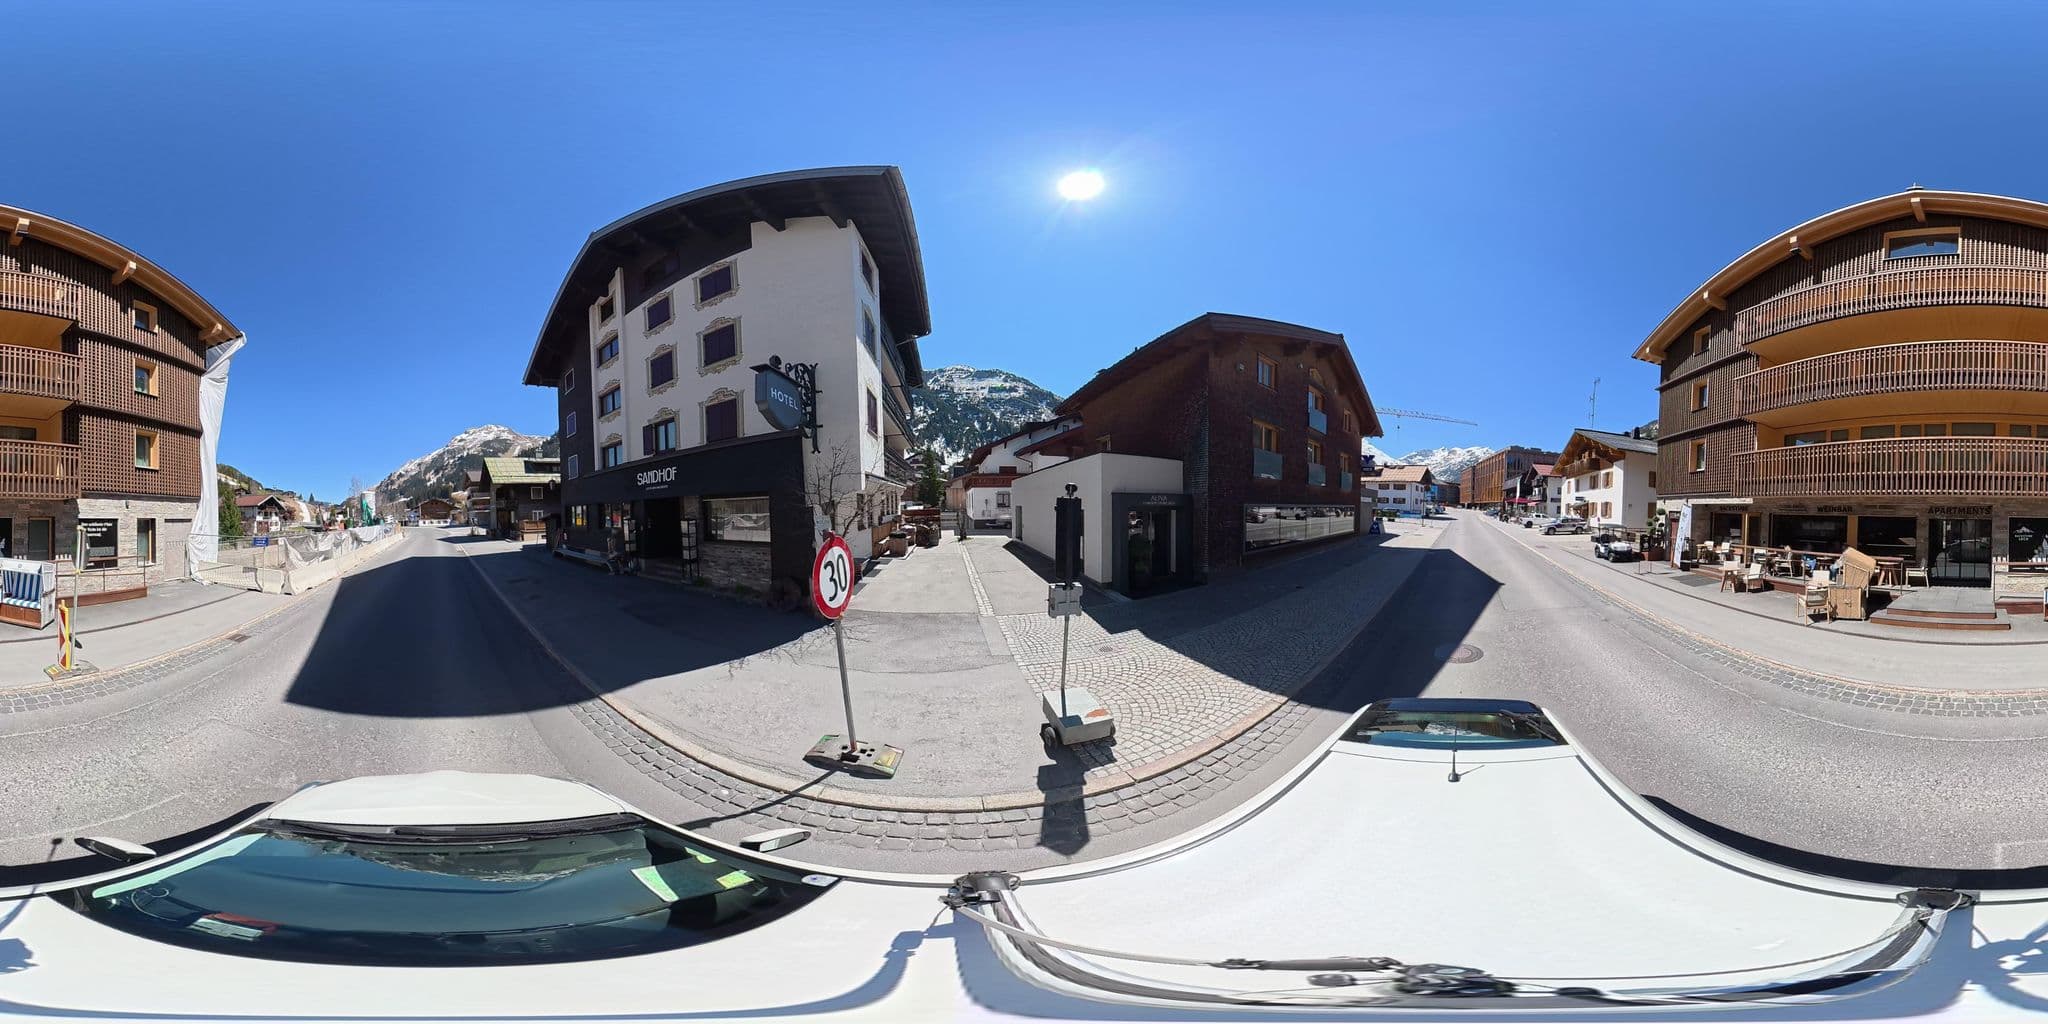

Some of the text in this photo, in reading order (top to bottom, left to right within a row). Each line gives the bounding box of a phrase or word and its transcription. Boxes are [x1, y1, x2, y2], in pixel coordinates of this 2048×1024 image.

[770, 387, 799, 410] HOTEL
[636, 466, 677, 486] SANDHOF
[1816, 504, 1853, 513] WEINBAR
[1928, 505, 1992, 515] APARTMENTS
[823, 553, 848, 602] 30
